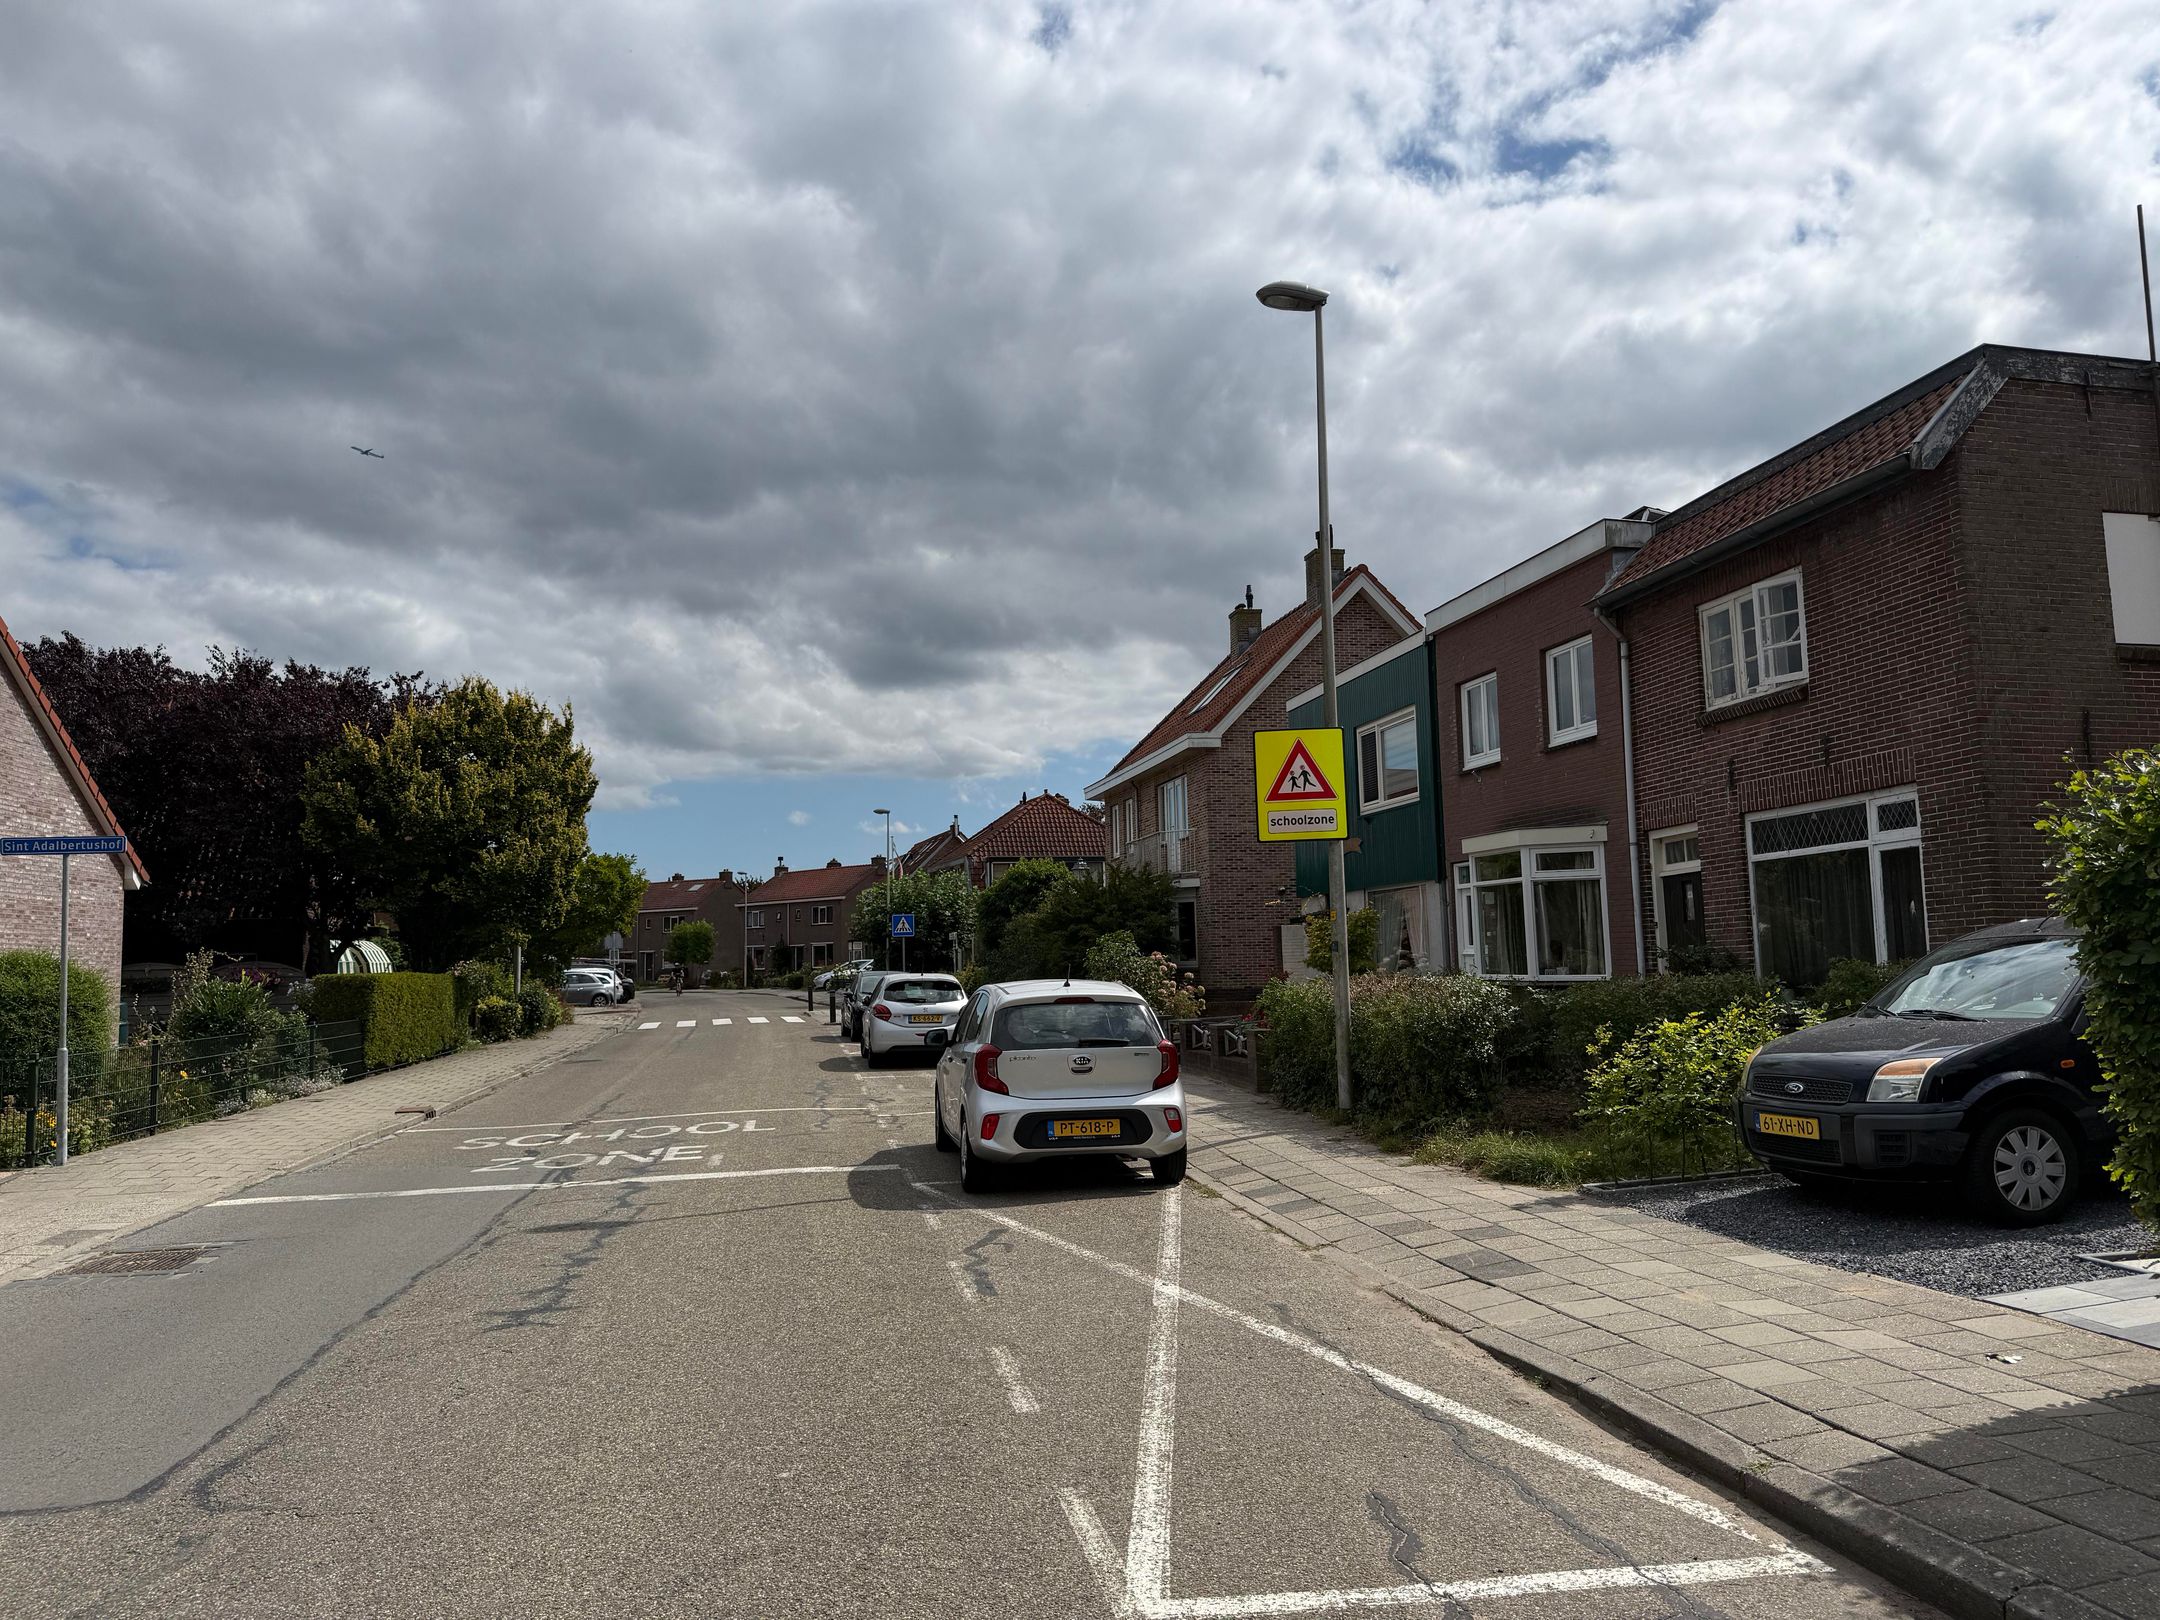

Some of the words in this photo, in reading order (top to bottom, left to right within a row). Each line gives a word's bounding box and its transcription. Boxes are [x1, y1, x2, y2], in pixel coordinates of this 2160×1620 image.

[1270, 814, 1335, 827] schoolzone
[4, 841, 29, 852] Sint
[32, 839, 121, 852] Adalbertushof
[453, 1119, 776, 1150] SCHOOL
[1060, 1120, 1114, 1135] PT-618-P
[1763, 1116, 1815, 1136] 61-XH-ND
[470, 1144, 709, 1173] ZONE
